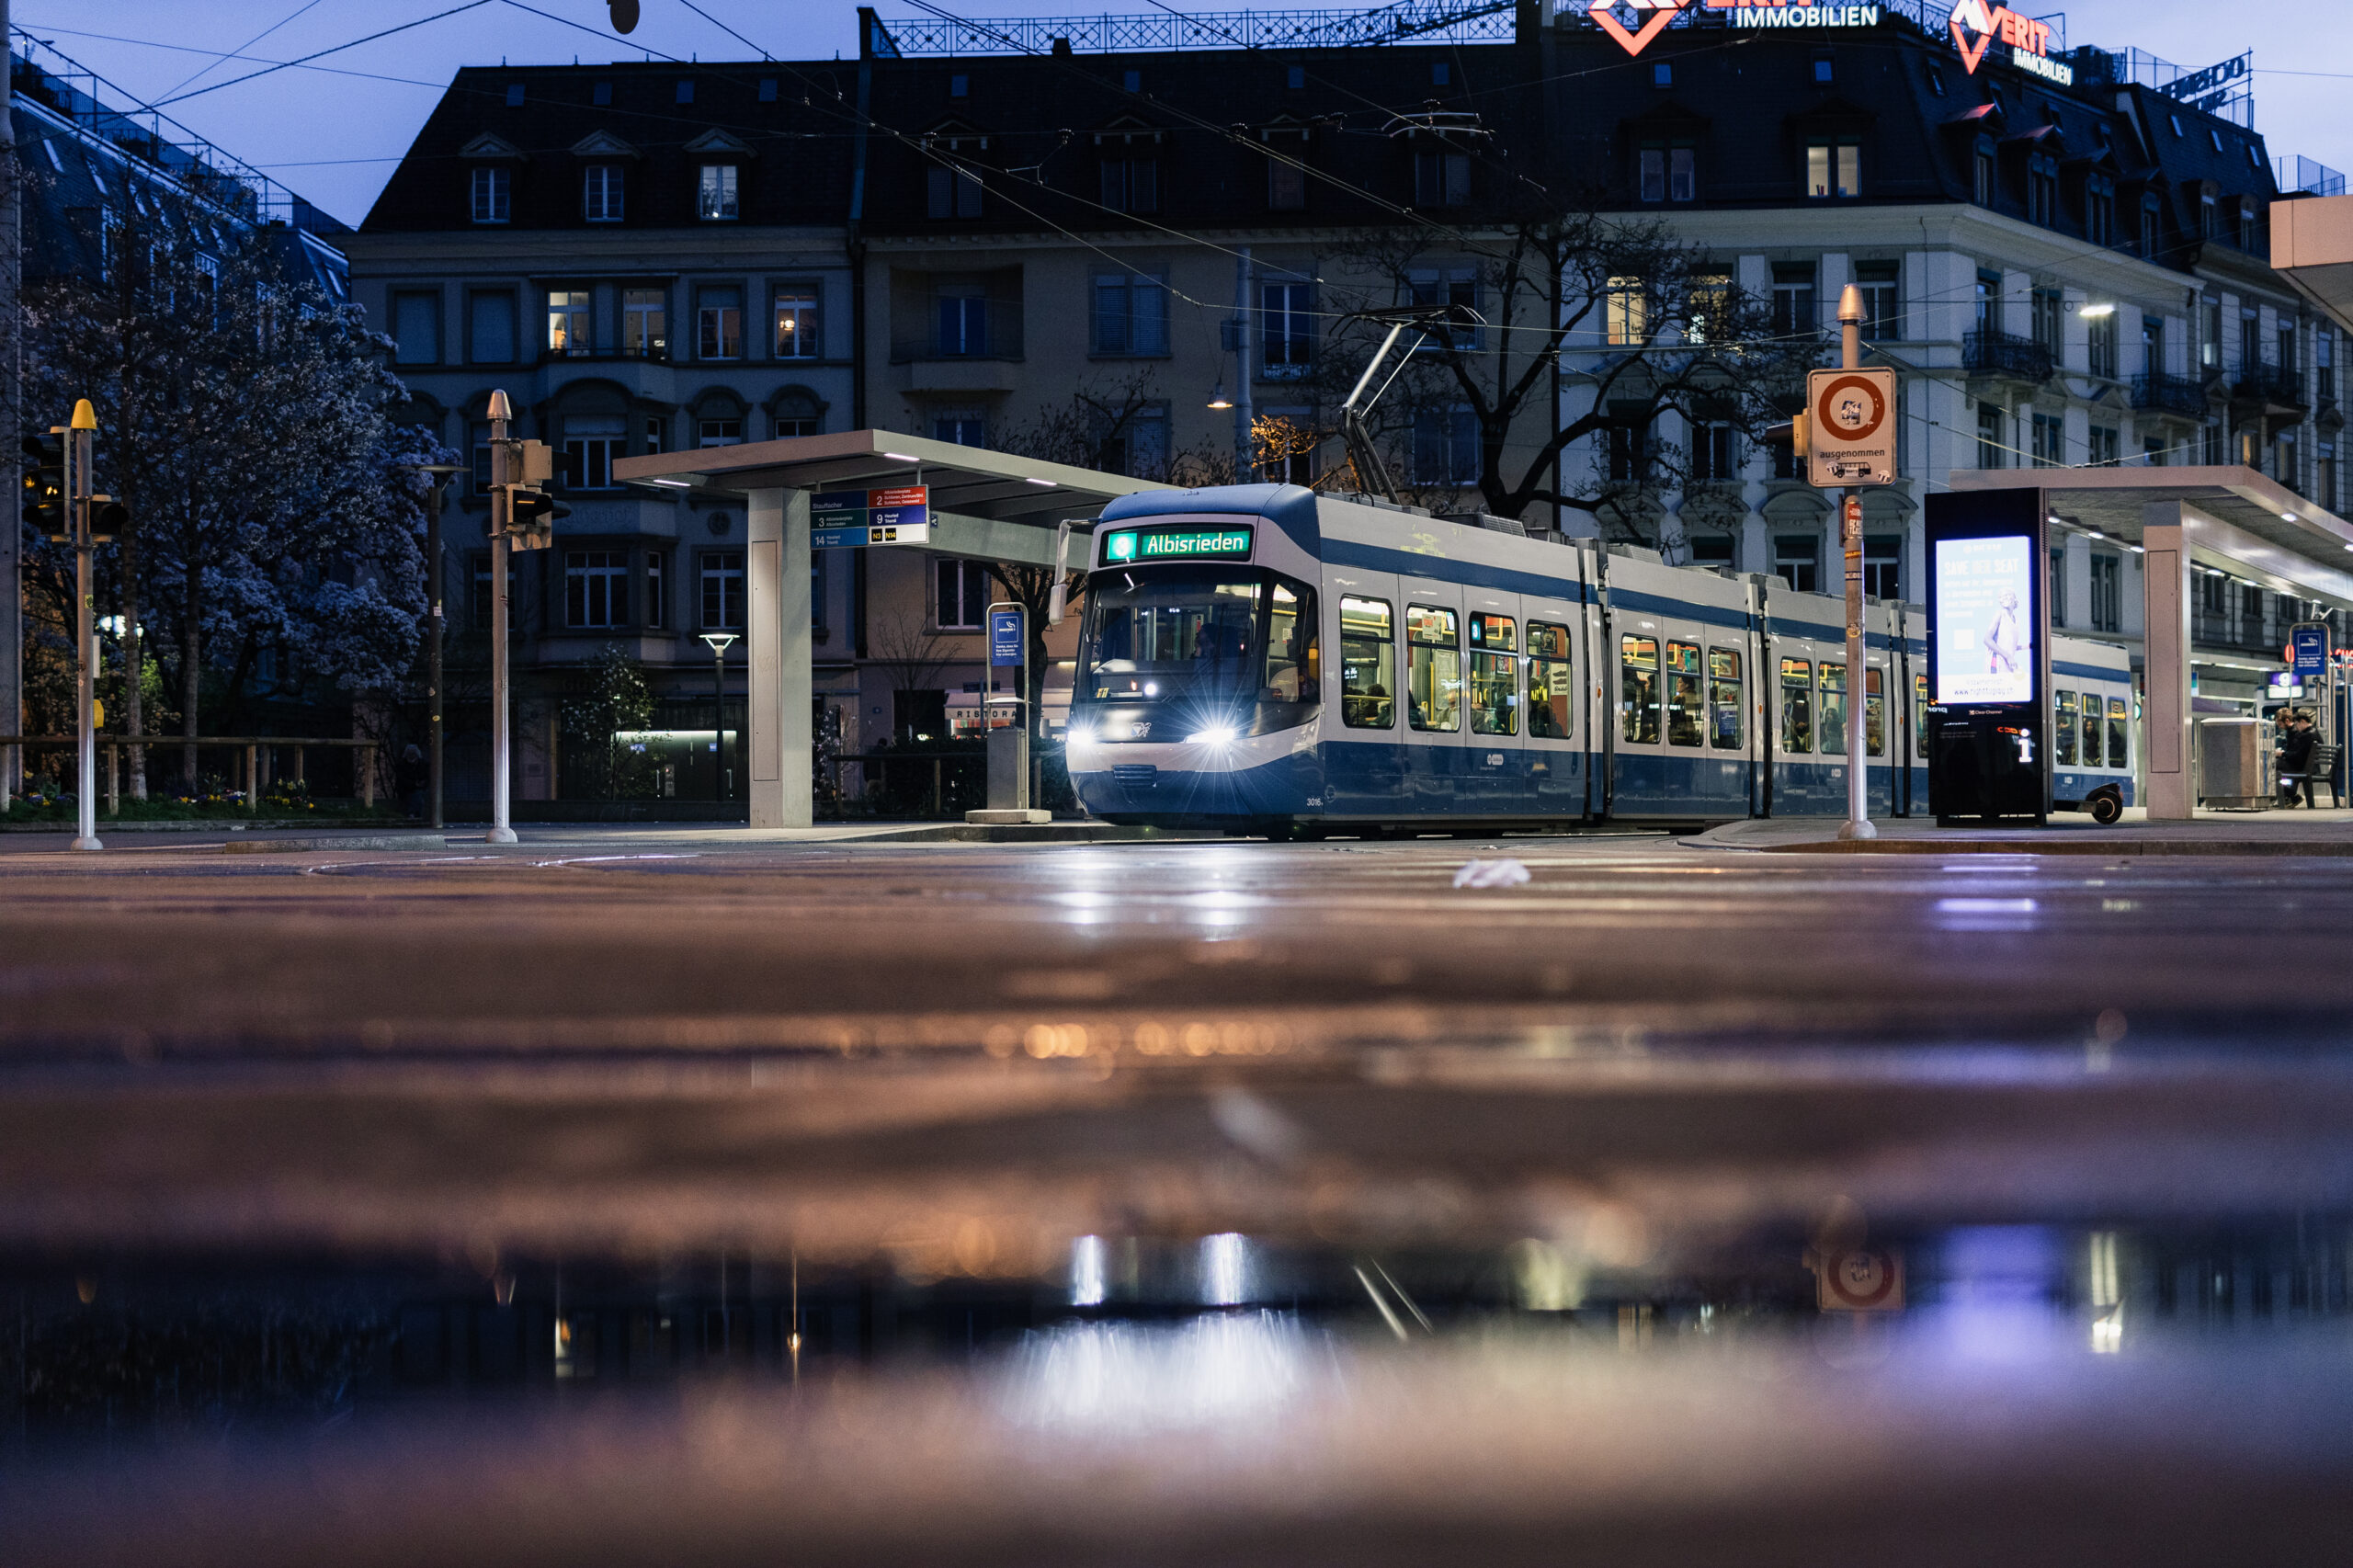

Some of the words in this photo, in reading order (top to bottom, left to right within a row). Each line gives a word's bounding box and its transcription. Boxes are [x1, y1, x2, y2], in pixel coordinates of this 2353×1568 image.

[1735, 6, 1879, 28] IMMOBILIEN
[1979, 0, 2050, 57] VERIT
[2013, 47, 2072, 86] IMMOBILIEN
[1819, 449, 1884, 460] ausgenommen
[876, 495, 882, 506] 2
[818, 517, 825, 528] 3
[876, 514, 883, 524] 9
[814, 536, 825, 546] 14
[1116, 536, 1130, 557] 3
[1147, 533, 1244, 553] Albisrieden
[1944, 559, 1970, 576] SAVE
[1994, 558, 2019, 574] SEAT
[1472, 624, 1478, 638] 3
[2279, 672, 2290, 687] 9
